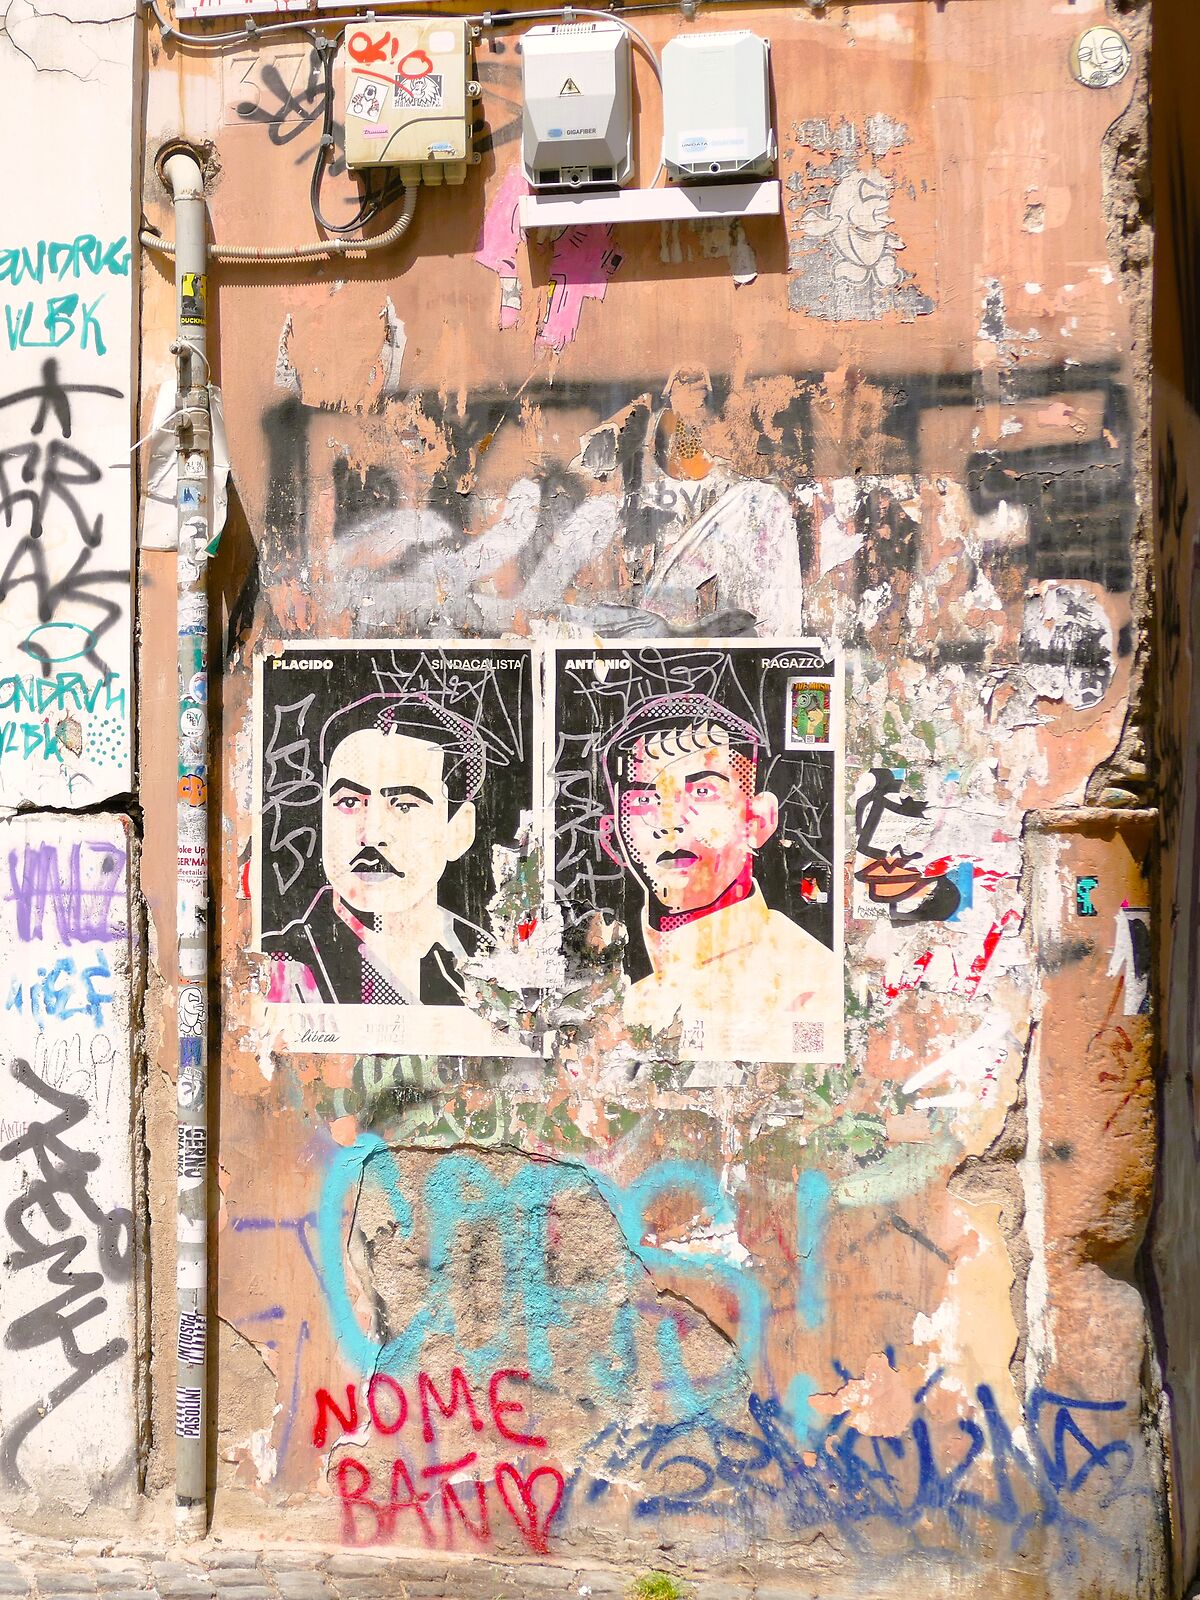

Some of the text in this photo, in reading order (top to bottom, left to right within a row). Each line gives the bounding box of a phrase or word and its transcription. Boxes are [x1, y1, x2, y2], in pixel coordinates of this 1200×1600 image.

[566, 127, 597, 137] GIGAFIBER
[272, 658, 523, 671] PLACIDO SINDACALISTA
[761, 657, 825, 670] RAGAZZO
[177, 845, 206, 857] oke Up
[177, 1312, 195, 1362] PASOLINI
[183, 1389, 202, 1438] PASOLINI
[311, 1365, 547, 1451] NOME
